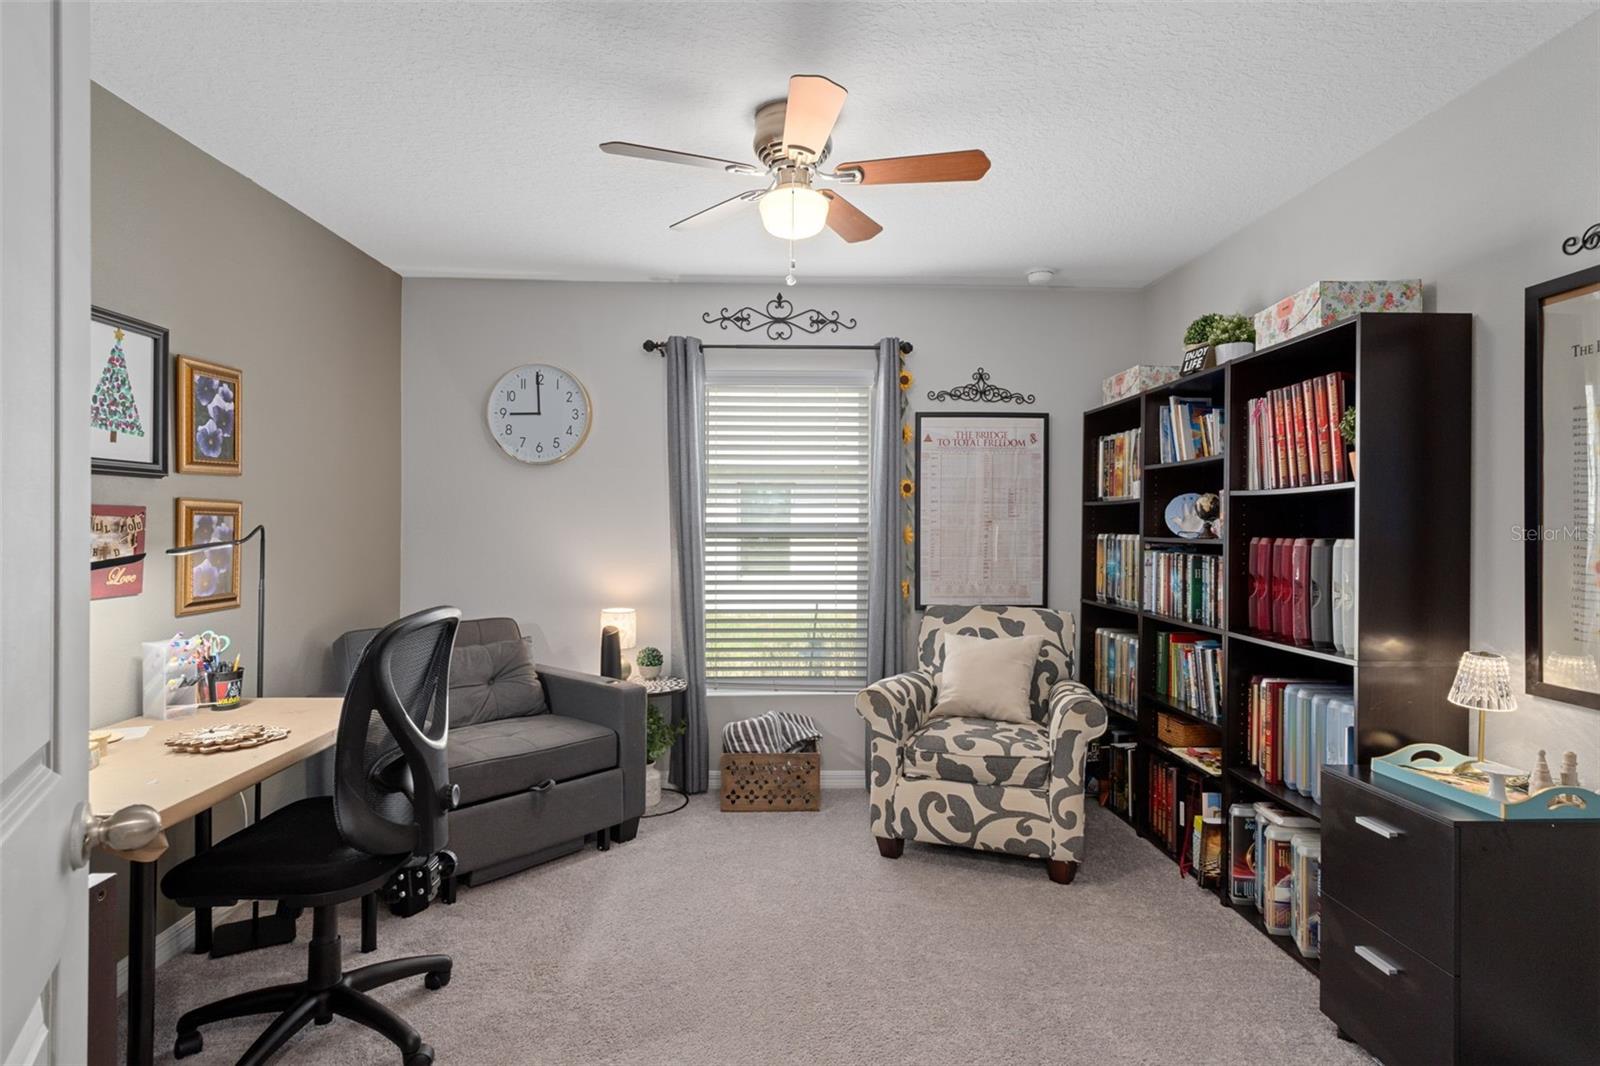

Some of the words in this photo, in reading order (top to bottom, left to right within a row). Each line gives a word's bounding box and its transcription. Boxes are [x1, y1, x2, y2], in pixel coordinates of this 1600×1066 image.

[1185, 346, 1208, 362] ENJOY
[1571, 344, 1594, 358] THE
[1183, 357, 1203, 372] LIFE
[506, 390, 516, 402] 10
[566, 391, 573, 403] 2
[499, 407, 507, 419] 9
[572, 408, 579, 420] 3
[505, 423, 513, 436] 8
[565, 425, 573, 436] 4
[955, 431, 974, 439] THE
[976, 431, 1008, 440] BRIDGE
[519, 436, 527, 448] 7
[535, 441, 543, 454] 6
[552, 437, 560, 449] 5
[937, 438, 950, 447] TO
[953, 438, 980, 447] TOTAL
[984, 439, 1026, 448] FREEDOM
[106, 566, 137, 585] Love
